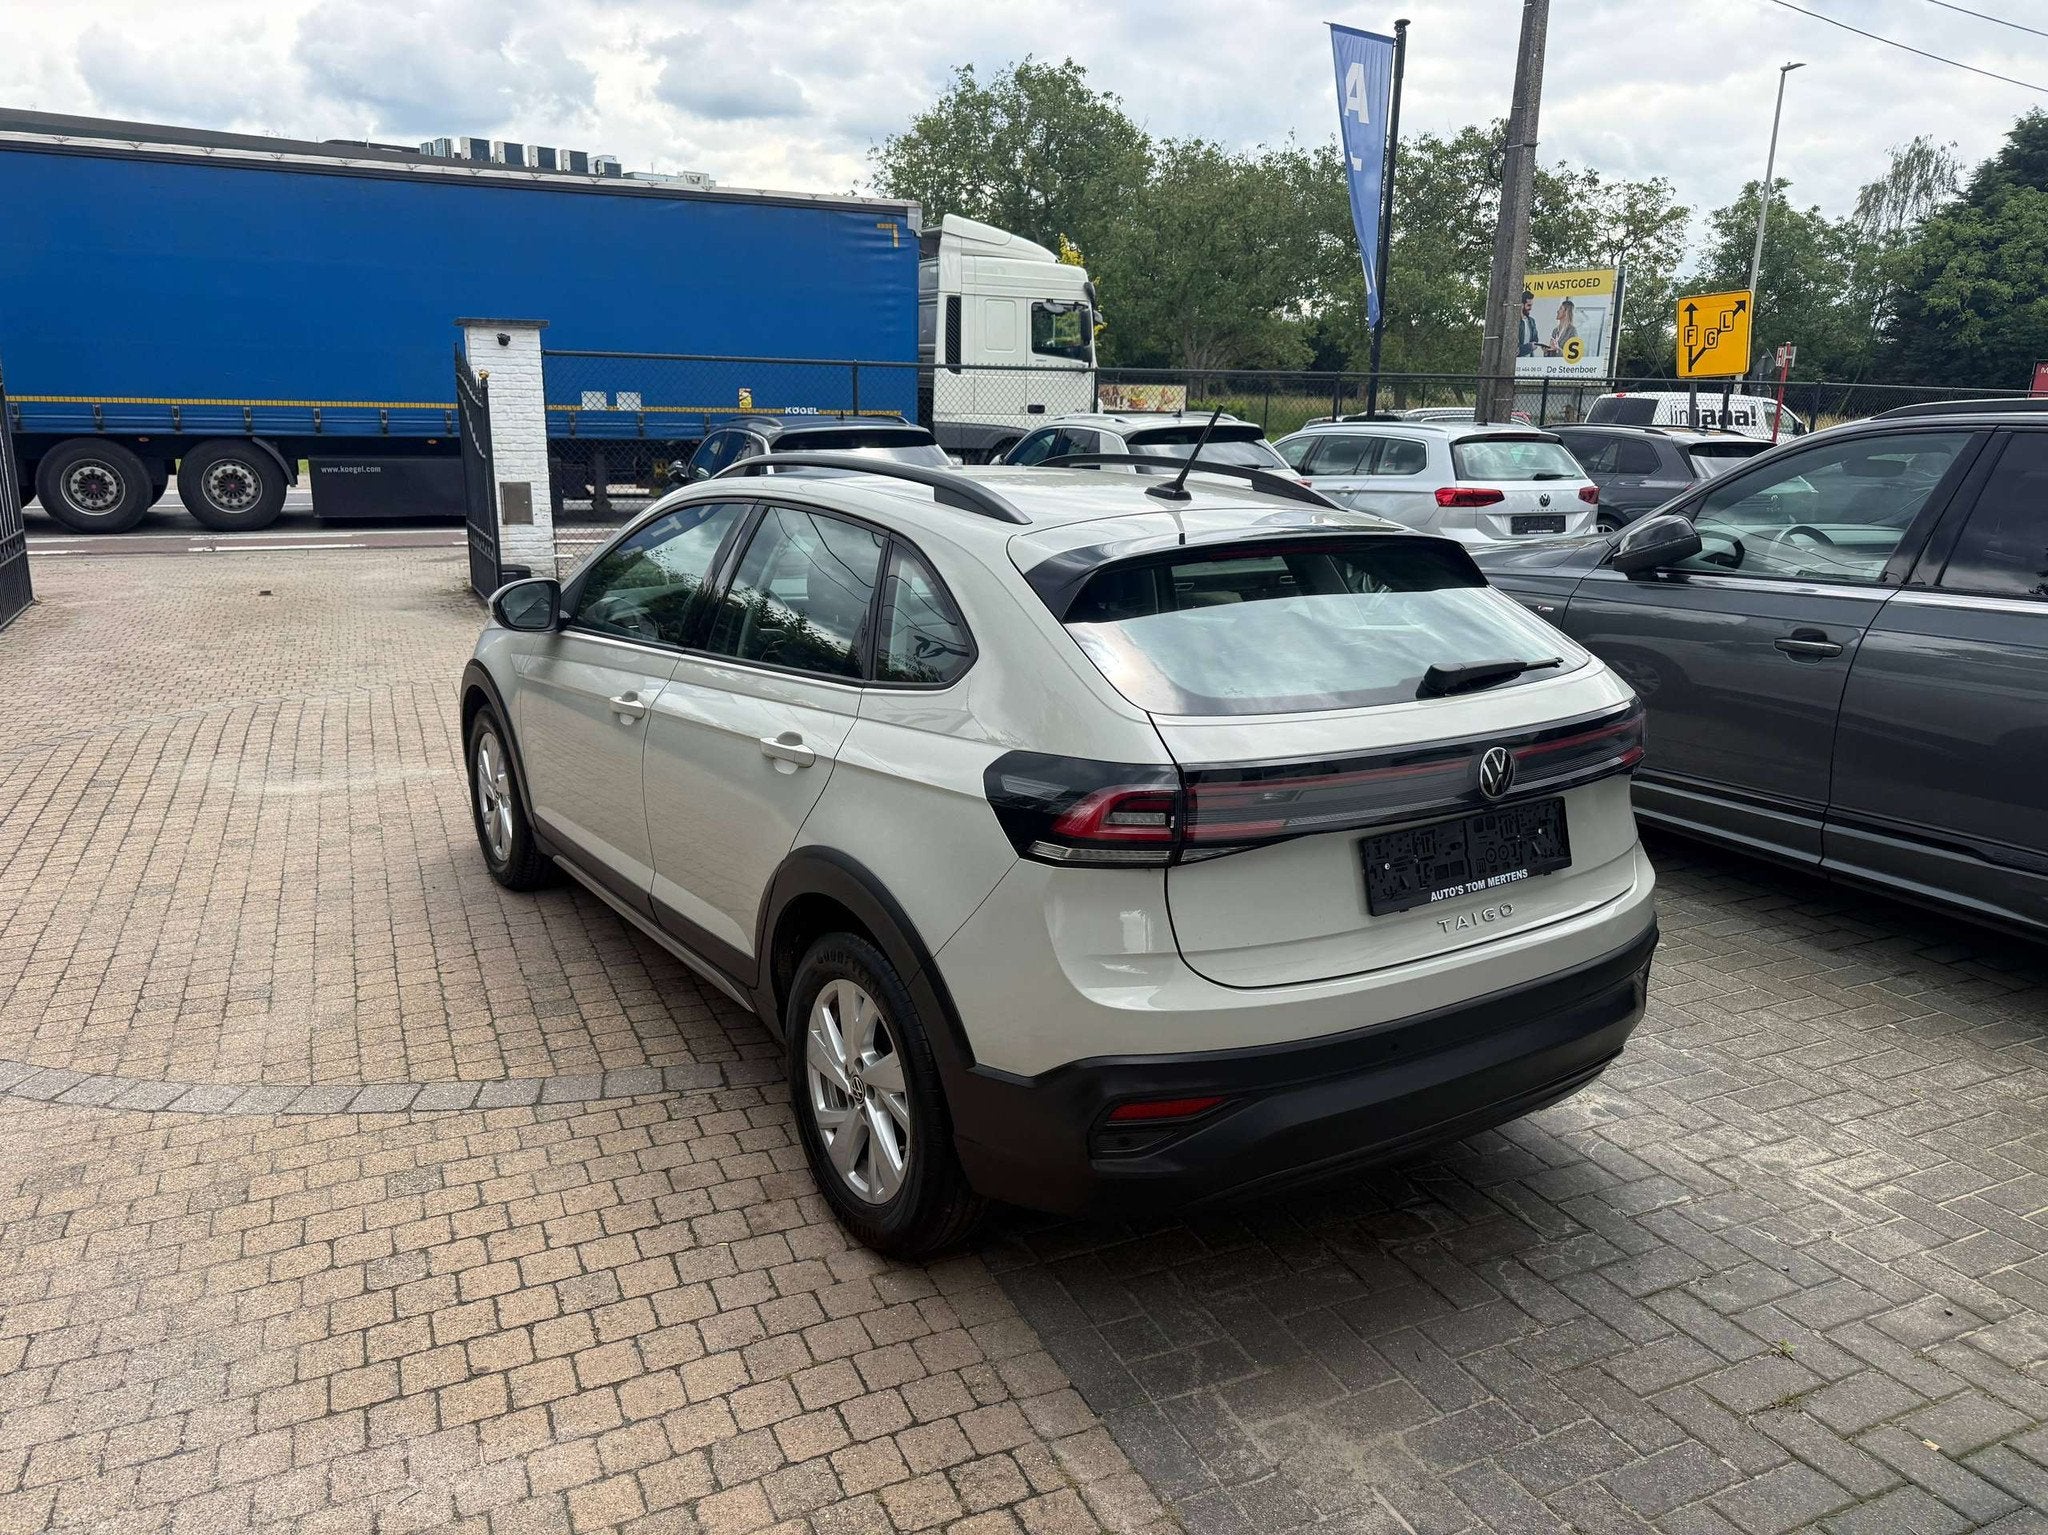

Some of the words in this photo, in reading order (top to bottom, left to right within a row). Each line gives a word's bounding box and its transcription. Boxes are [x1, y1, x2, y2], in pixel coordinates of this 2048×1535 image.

[1533, 281, 1544, 291] IN
[1546, 277, 1601, 290] VASTGOED
[1722, 313, 1731, 329] L
[1686, 328, 1695, 343] F
[1706, 331, 1716, 346] G
[1546, 365, 1557, 374] De
[1558, 365, 1597, 374] Steenboer
[320, 466, 381, 474] www.koegel.com
[1430, 885, 1465, 902] AUTO'S
[1465, 879, 1486, 893] TOM
[1487, 868, 1528, 888] MERTENS
[1437, 902, 1514, 933] TAIGO
